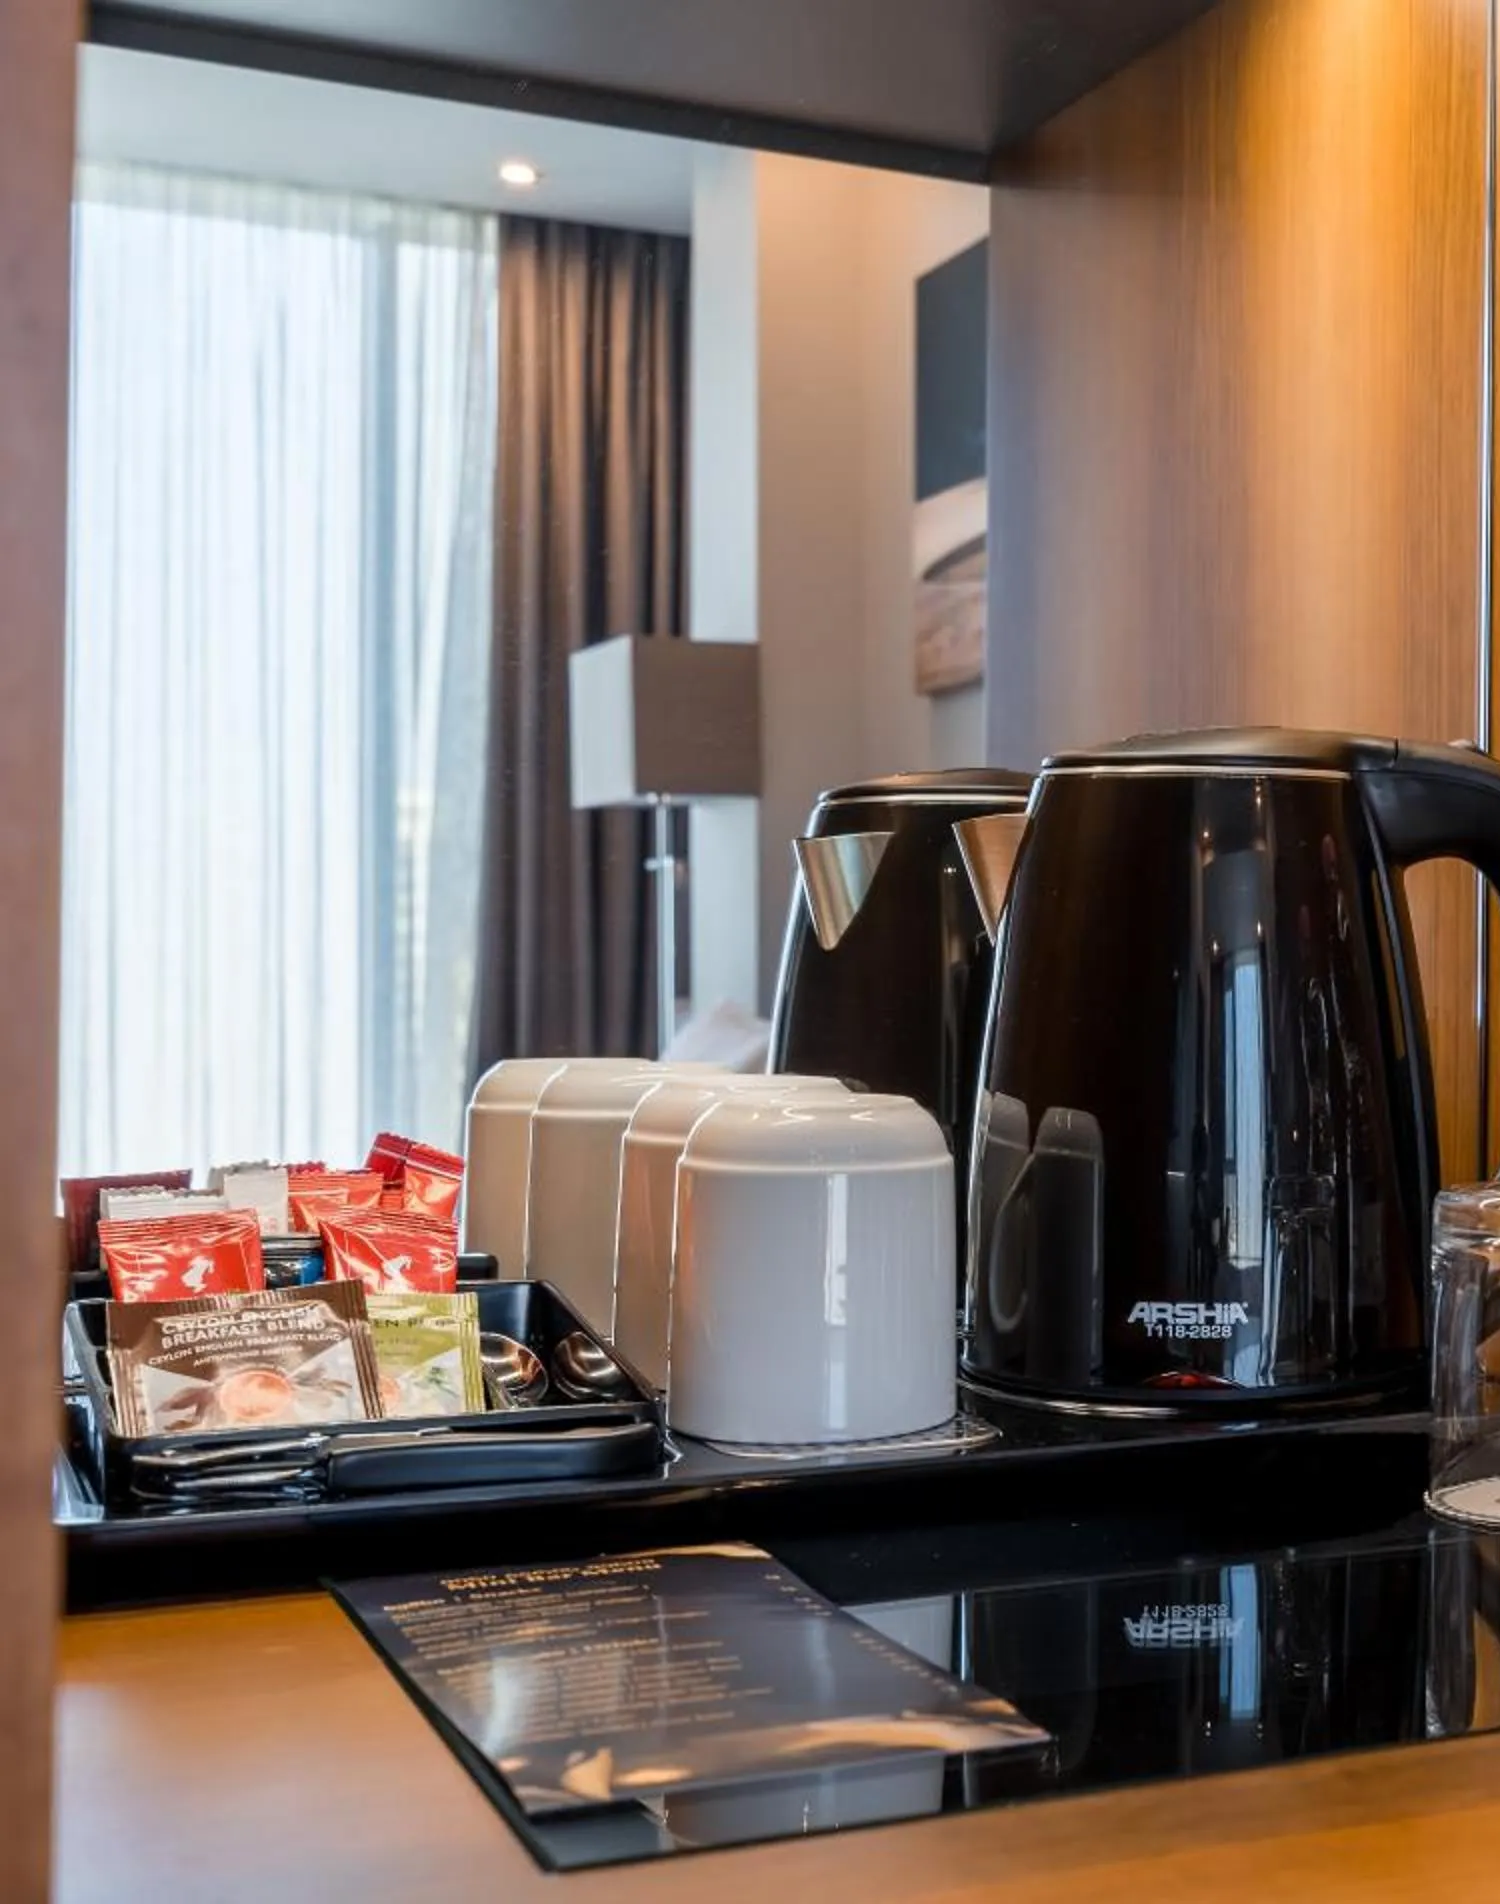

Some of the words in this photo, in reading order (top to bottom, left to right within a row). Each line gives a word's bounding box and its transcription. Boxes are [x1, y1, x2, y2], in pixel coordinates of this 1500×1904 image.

[161, 1314, 235, 1335] CEYLON
[1127, 1302, 1248, 1325] ARSHIA
[161, 1323, 260, 1349] BREAKFAST
[267, 1317, 326, 1333] BLEND
[1145, 1323, 1232, 1339] T118-2828
[149, 1347, 193, 1366] CEYLON
[195, 1339, 244, 1354] ENGLISH
[246, 1333, 306, 1348] BREAKFAST
[307, 1333, 343, 1342] BLEND
